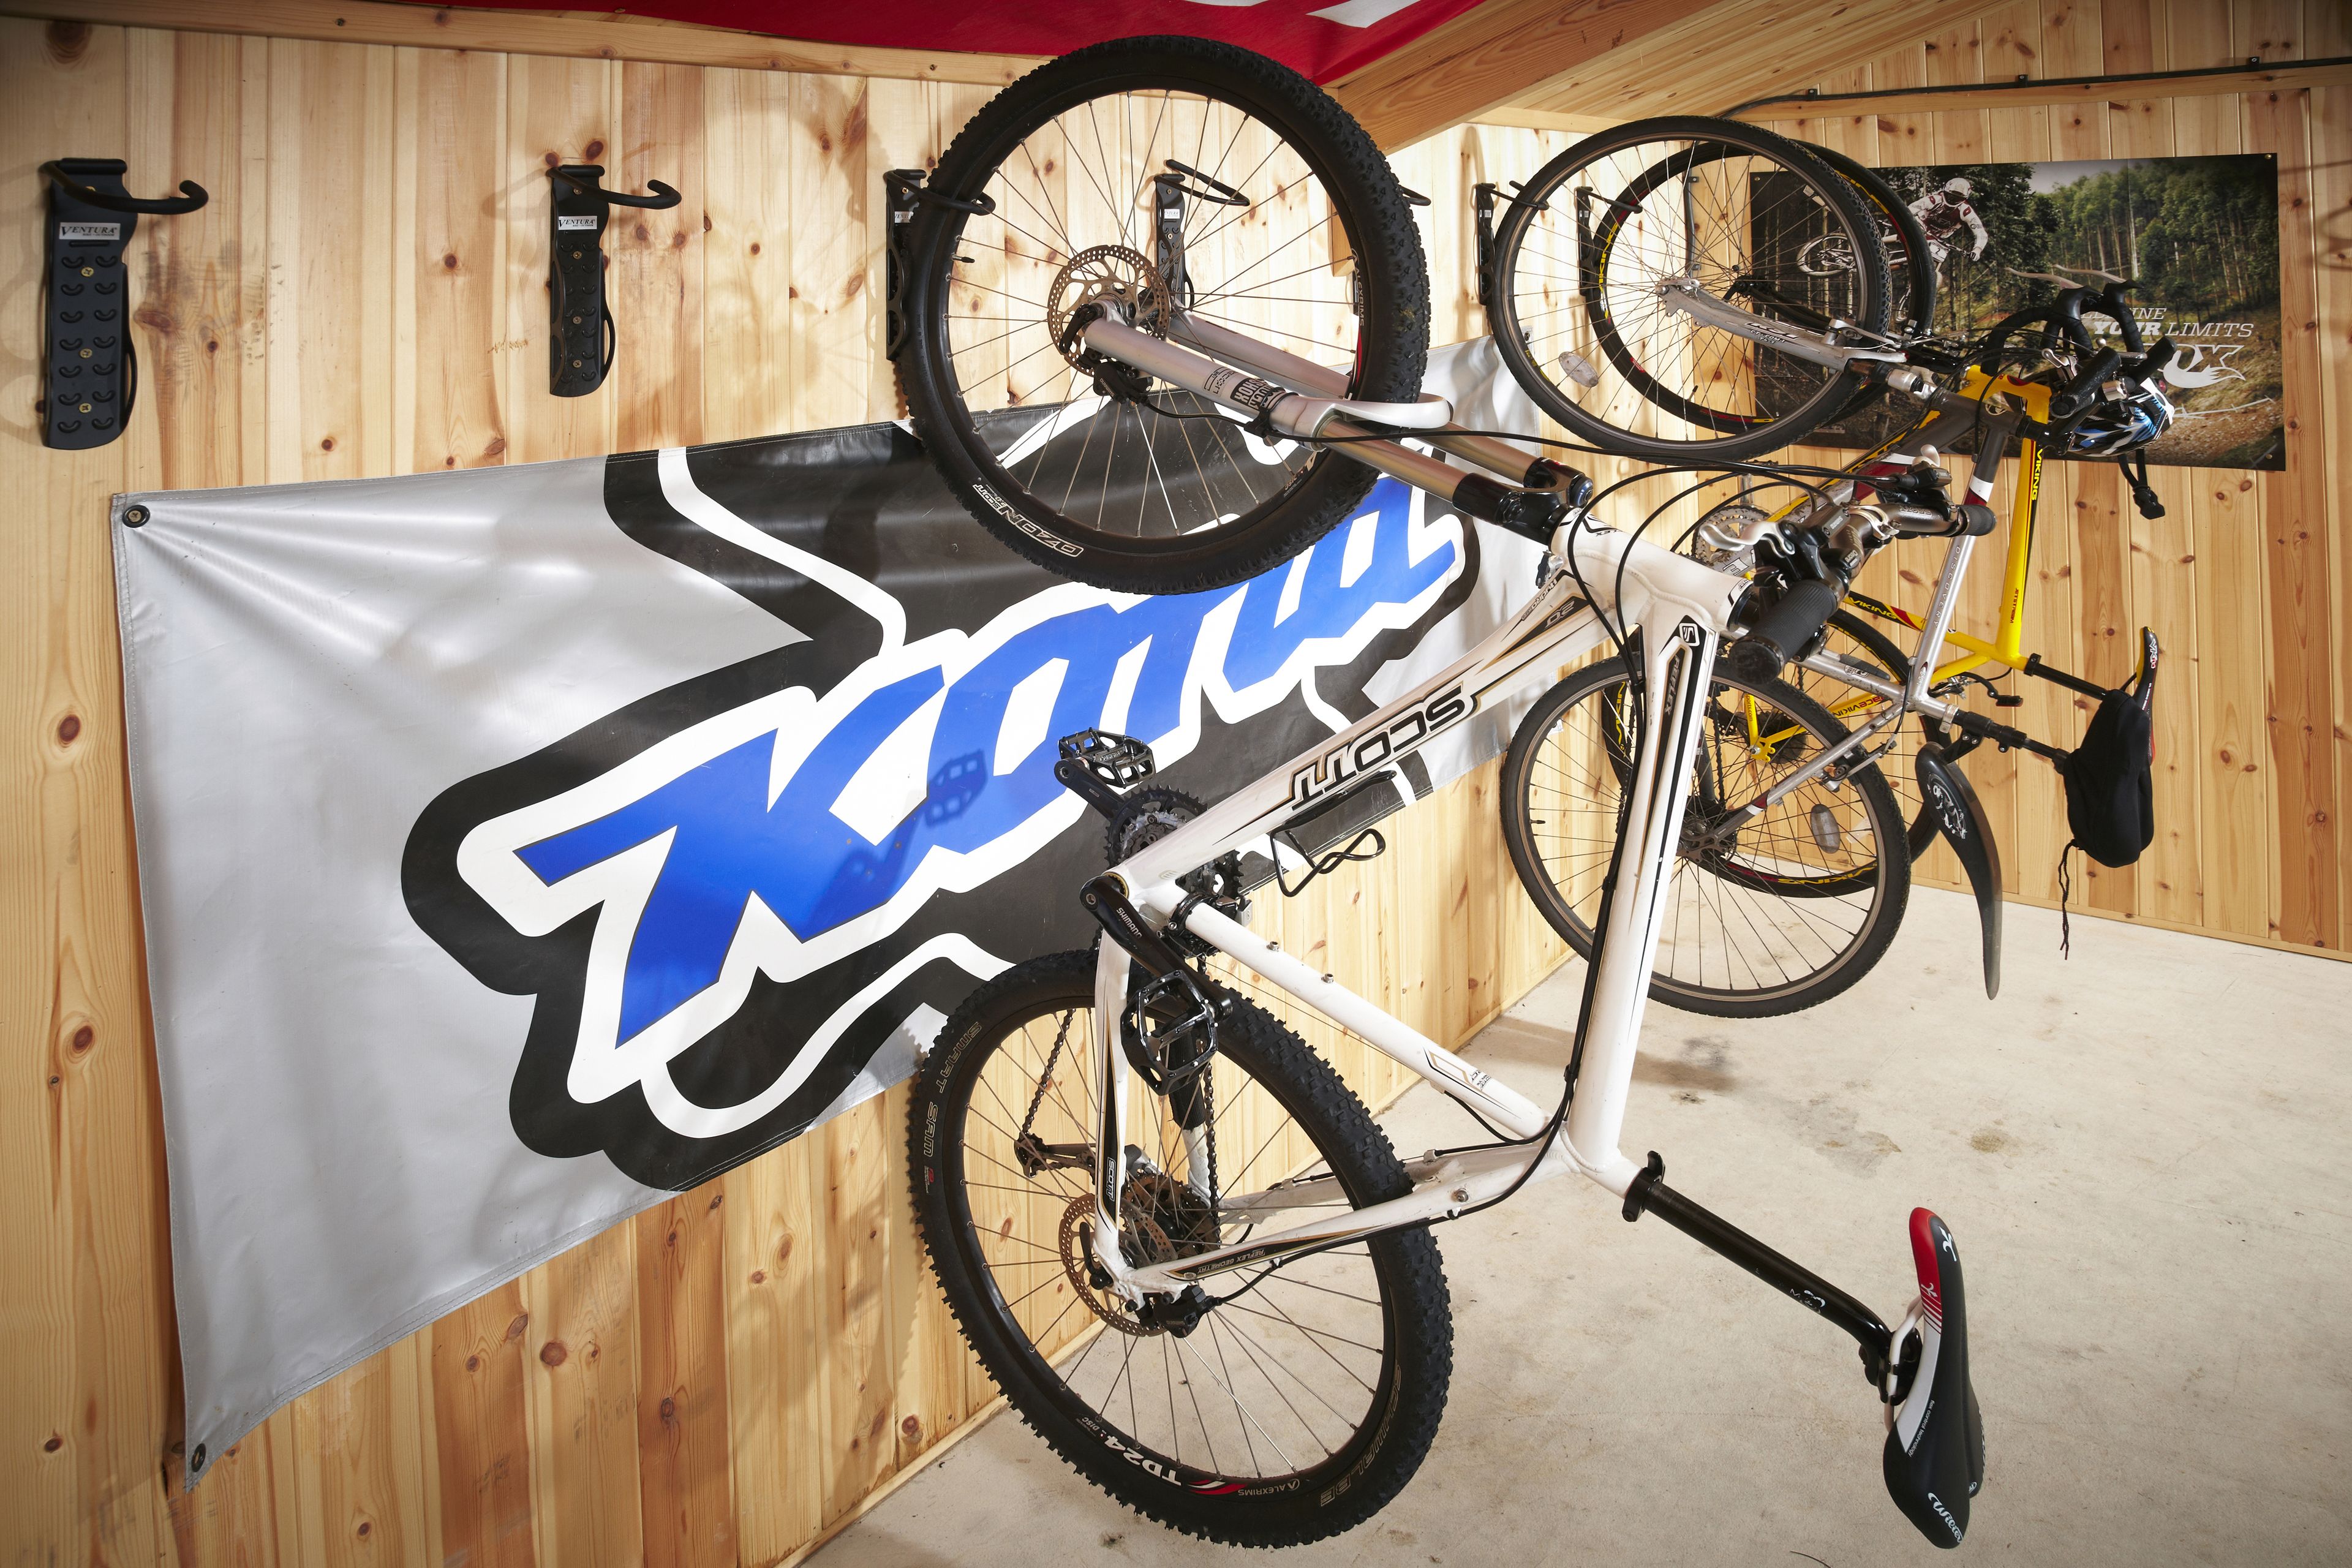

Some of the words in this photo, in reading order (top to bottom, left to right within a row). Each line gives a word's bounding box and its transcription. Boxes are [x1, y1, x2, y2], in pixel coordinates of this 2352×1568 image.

[61, 226, 116, 236] VENTURA
[2165, 322, 2254, 337] LIMITS
[1099, 377, 1115, 398] SHIMANO
[1235, 378, 1264, 402] SHOX
[2032, 448, 2043, 500] VIKING
[973, 484, 1003, 510] SCOTT
[1899, 505, 1932, 516] SCOTT
[1000, 505, 1084, 557] OZON
[1933, 546, 1961, 628] DISCOVERY
[1850, 597, 1898, 619] VIKING
[1664, 654, 1680, 716] REFLEX
[1292, 685, 1465, 811] SCOTT
[1116, 907, 1142, 939] SHIMANO
[937, 1021, 982, 1093] SMART
[924, 1102, 938, 1157] SAM
[1107, 1158, 1115, 1200] SCOTT
[1197, 1259, 1235, 1273] GEOMETRY
[1236, 1248, 1265, 1262] REFLEX
[1082, 1417, 1100, 1431] DISC
[1921, 1409, 1931, 1430] control
[1321, 1363, 1401, 1507] SCHWALBE
[1907, 1430, 1924, 1458] technology
[1104, 1435, 1182, 1486] TD24
[1238, 1483, 1286, 1496] ALEXRIMS
